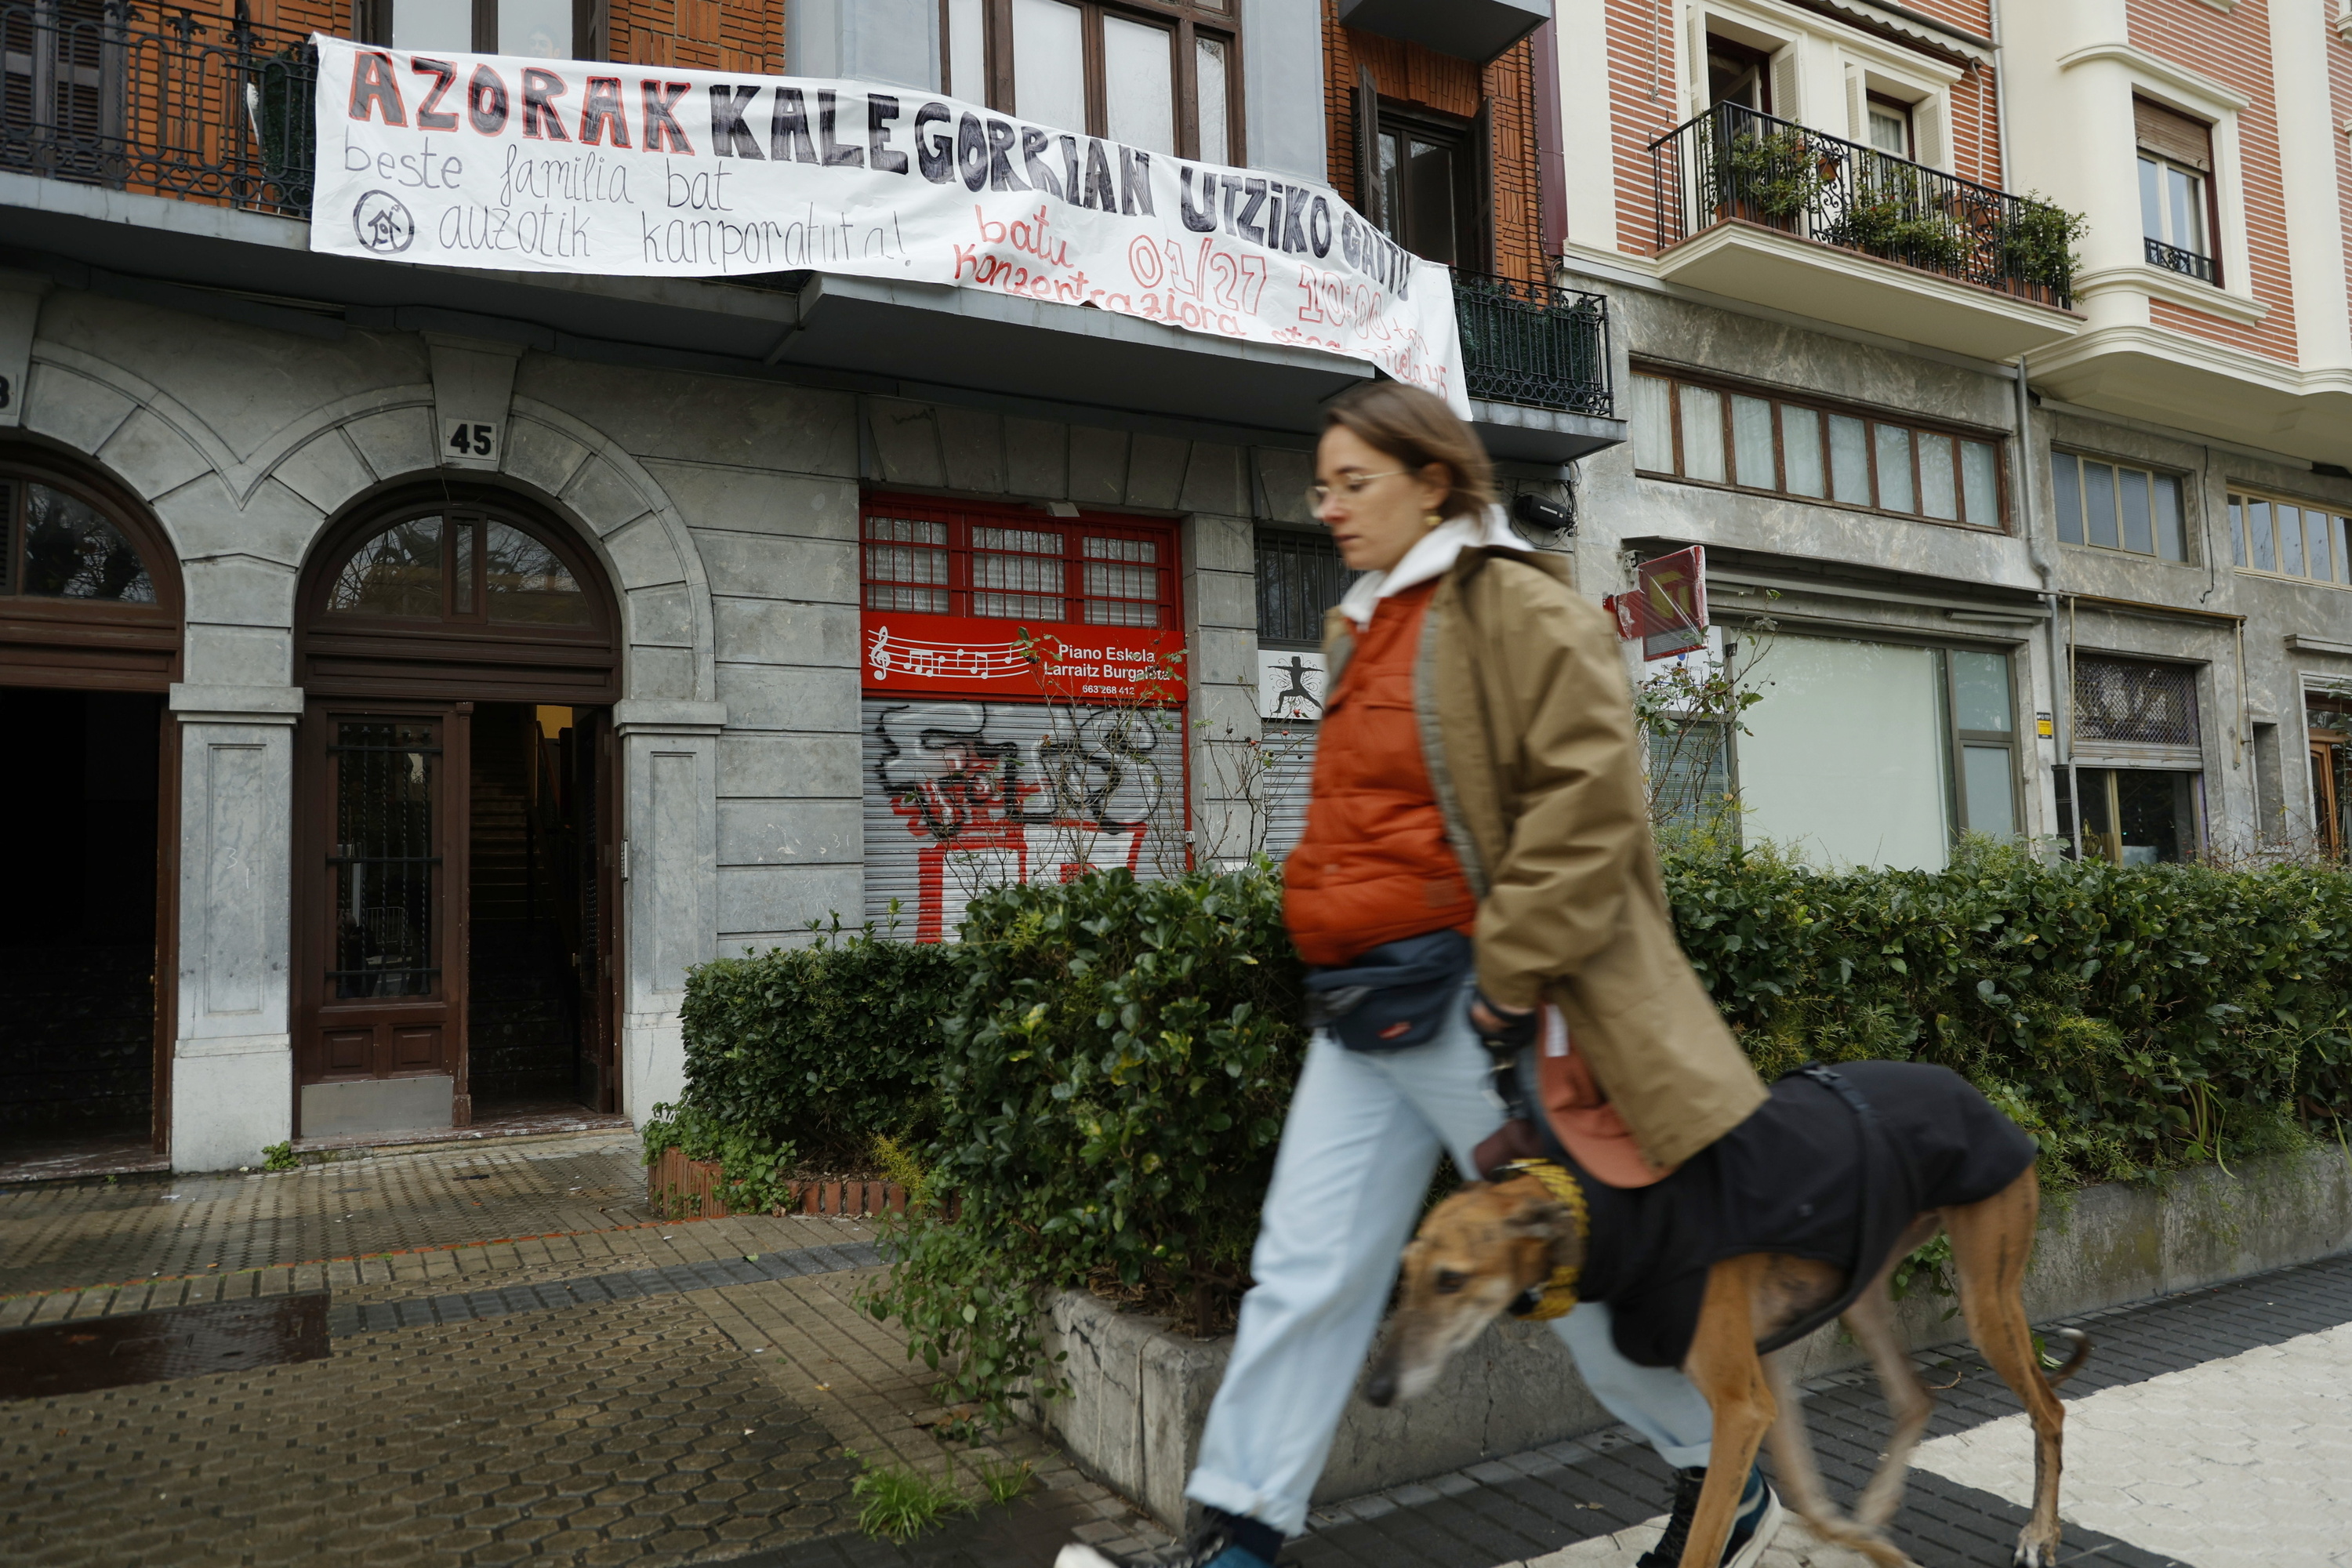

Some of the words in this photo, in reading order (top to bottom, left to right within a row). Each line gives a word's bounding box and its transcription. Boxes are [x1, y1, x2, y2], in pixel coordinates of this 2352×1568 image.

[348, 51, 695, 156] AZORAK
[344, 125, 463, 189] beste
[499, 144, 634, 208] familia
[666, 157, 734, 211] bat
[439, 203, 591, 257] auzotik
[975, 204, 1076, 269] batu
[1127, 234, 1268, 317] 01/27
[1298, 264, 1392, 341] 10:00
[450, 423, 492, 456] 45
[1044, 661, 1100, 677] Larraitz
[1058, 644, 1102, 660] Piano
[1106, 647, 1156, 662] Eskola
[1082, 684, 1099, 694] 663
[1101, 685, 1117, 695] 268
[1118, 686, 1135, 695] 412
